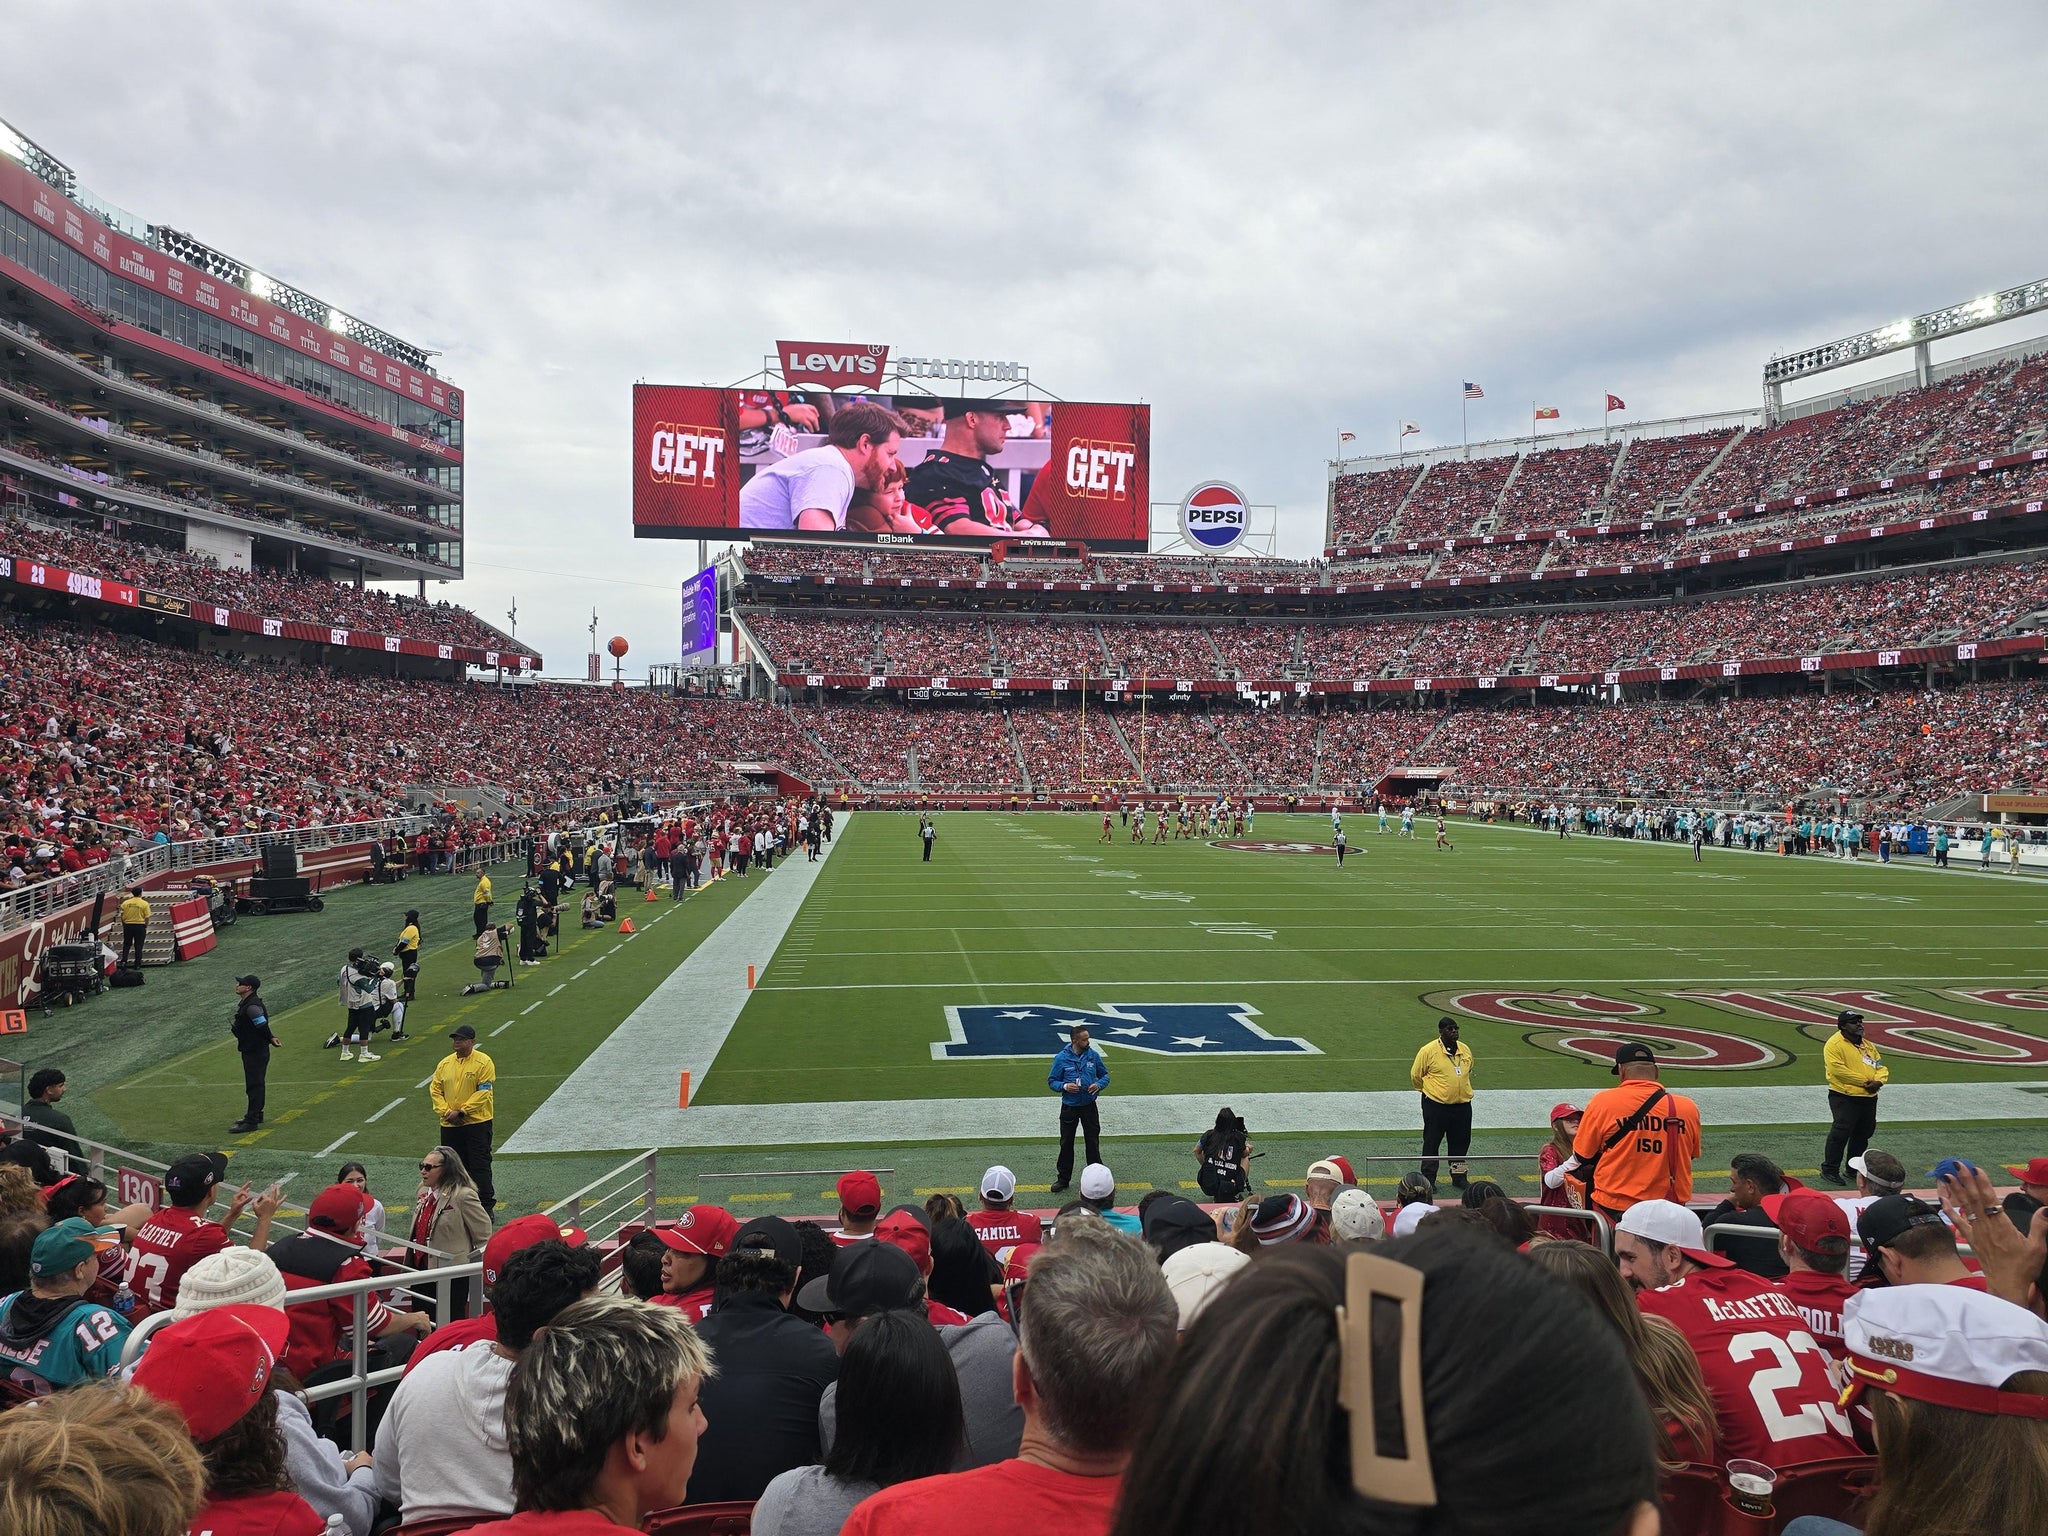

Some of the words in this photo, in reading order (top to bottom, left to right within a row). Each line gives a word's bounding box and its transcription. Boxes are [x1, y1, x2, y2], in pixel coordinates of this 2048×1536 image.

[34, 200, 55, 224] OWENS
[65, 221, 84, 245] OWENS
[93, 240, 110, 262] PERRY
[132, 250, 144, 263] TOM
[120, 256, 155, 282] RATHMAN
[168, 277, 183, 294] RICE
[241, 308, 258, 327] CLAIR
[269, 322, 290, 340] TAYLOR
[300, 336, 320, 353] TITTLE
[330, 349, 350, 366] TURNER
[897, 357, 1020, 382] STADIUM
[392, 427, 408, 442] HOME
[651, 430, 724, 478] GET
[1067, 446, 1134, 492] GET
[1755, 504, 1766, 512] GET
[1794, 496, 1806, 505] GET
[1836, 488, 1849, 497] GET
[1881, 479, 1894, 488] GET
[1928, 470, 1943, 480] GET
[1978, 459, 1993, 469] GET
[2032, 449, 2048, 459] GET
[1189, 510, 1243, 524] PEPSI
[1824, 535, 1837, 544] GET
[1870, 527, 1885, 536] GET
[1920, 519, 1935, 528] GET
[1972, 510, 1989, 520] GET
[2026, 501, 2043, 512] GET
[891, 534, 913, 543] bank
[31, 565, 45, 584] 28
[67, 572, 102, 599] 49ERS
[128, 590, 132, 603] 3
[215, 607, 229, 626] GET
[263, 619, 282, 636] GET
[331, 629, 348, 645] GET
[385, 637, 400, 652] GET
[439, 645, 452, 659] GET
[486, 652, 499, 665] GET
[520, 657, 531, 669] GET
[807, 675, 824, 685] GET
[870, 677, 886, 687] GET
[932, 678, 948, 688] GET
[993, 679, 1009, 689] GET
[1053, 680, 1069, 690] GET
[1112, 681, 1128, 691] GET
[1177, 681, 1193, 691] GET
[1236, 682, 1252, 691] GET
[1295, 682, 1311, 692] GET
[1353, 681, 1370, 692] GET
[1414, 679, 1432, 690] GET
[1478, 677, 1497, 688] GET
[1540, 676, 1559, 687] GET
[1604, 672, 1619, 684] GET
[1661, 668, 1678, 680] GET
[1723, 663, 1740, 676] GET
[1801, 657, 1821, 671] GET
[1878, 651, 1900, 665] GET
[1957, 645, 1977, 659] GET
[1169, 693, 1191, 701] xfinity
[5, 1012, 22, 1031] G
[1616, 1116, 1686, 1134] VNDR
[1637, 1138, 1662, 1154] 150
[123, 1174, 154, 1207] 130
[1703, 1292, 1802, 1322] McCAFFRE
[76, 1310, 118, 1353] 12
[1868, 1336, 1914, 1361] 49ERS
